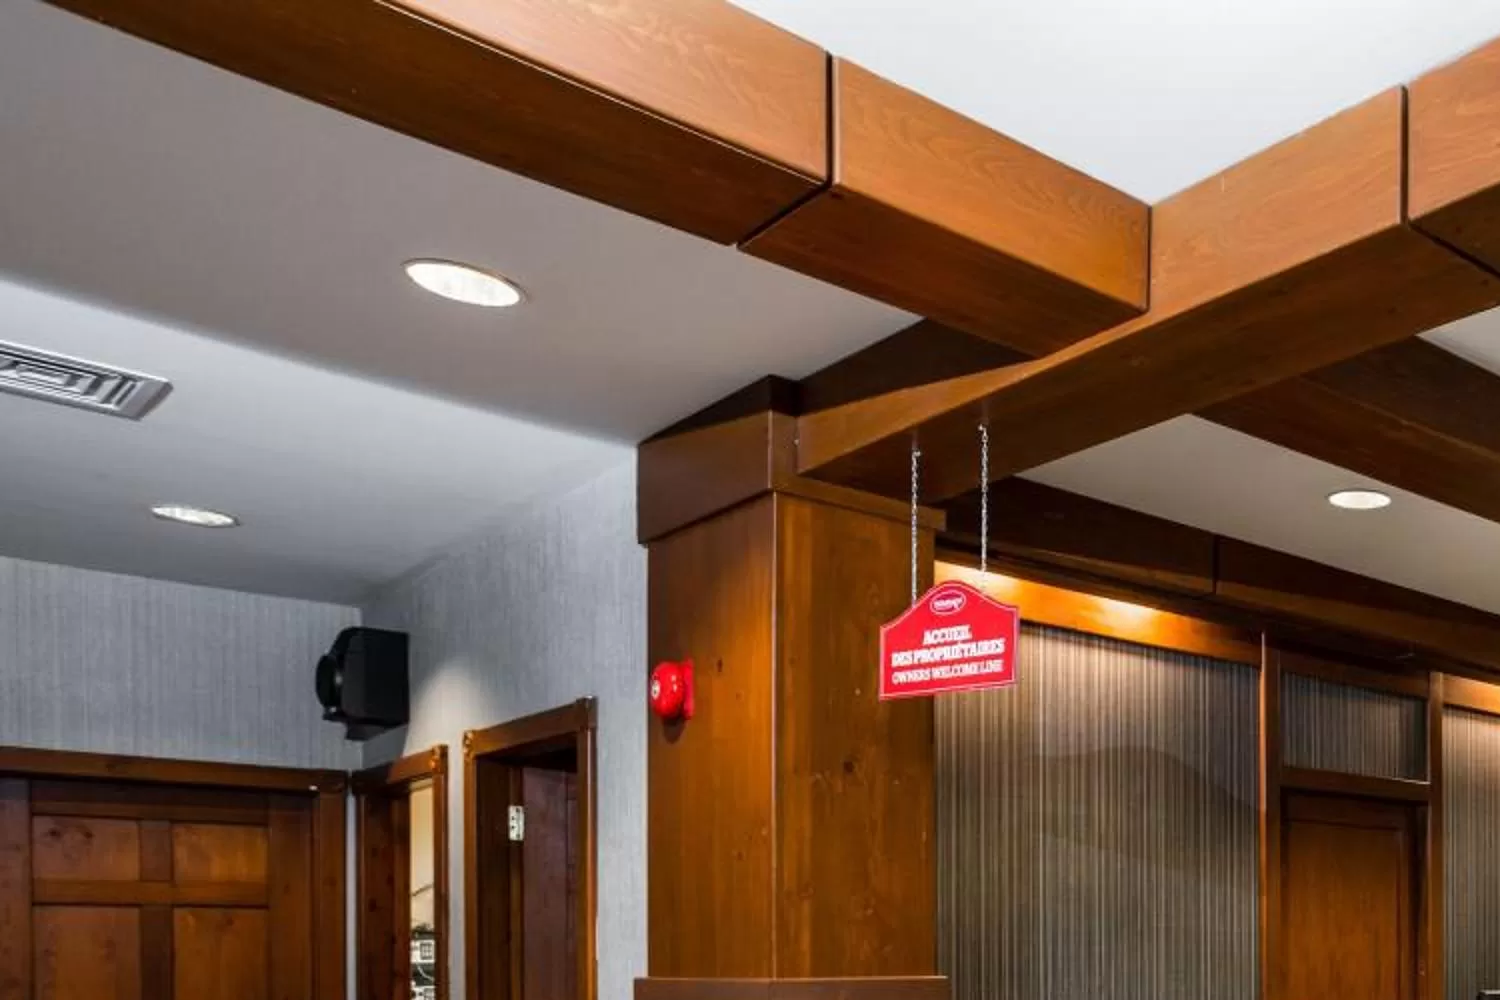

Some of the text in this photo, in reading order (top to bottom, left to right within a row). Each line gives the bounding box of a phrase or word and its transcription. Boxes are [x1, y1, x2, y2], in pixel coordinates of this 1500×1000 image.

[923, 624, 973, 645] ACCUEIL
[891, 650, 913, 668] DES
[892, 668, 930, 684] OWNERS
[931, 661, 979, 679] WELCOME
